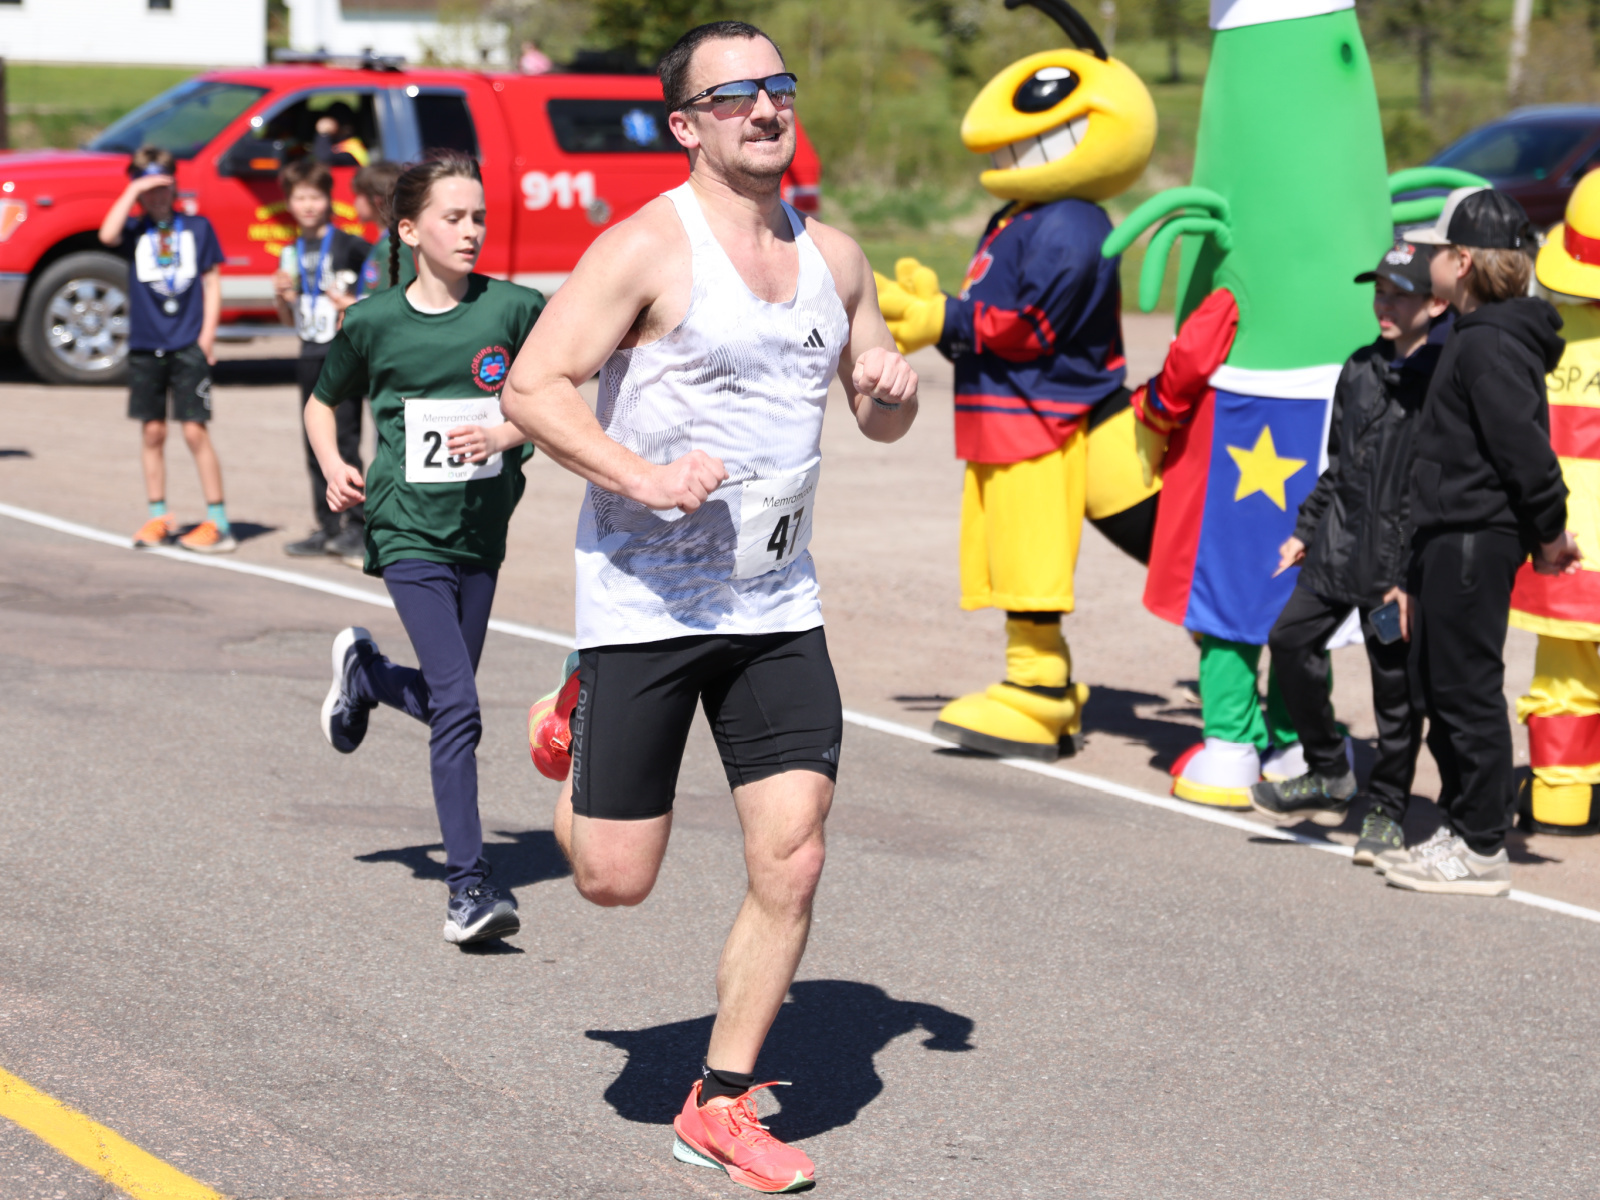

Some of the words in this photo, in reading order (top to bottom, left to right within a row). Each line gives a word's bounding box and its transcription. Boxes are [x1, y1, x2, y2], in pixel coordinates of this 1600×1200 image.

[520, 170, 597, 211] 911
[471, 346, 493, 375] COEURS
[422, 411, 488, 423] Memramcook
[766, 506, 805, 561] 47
[572, 689, 588, 793] ADIZERO
